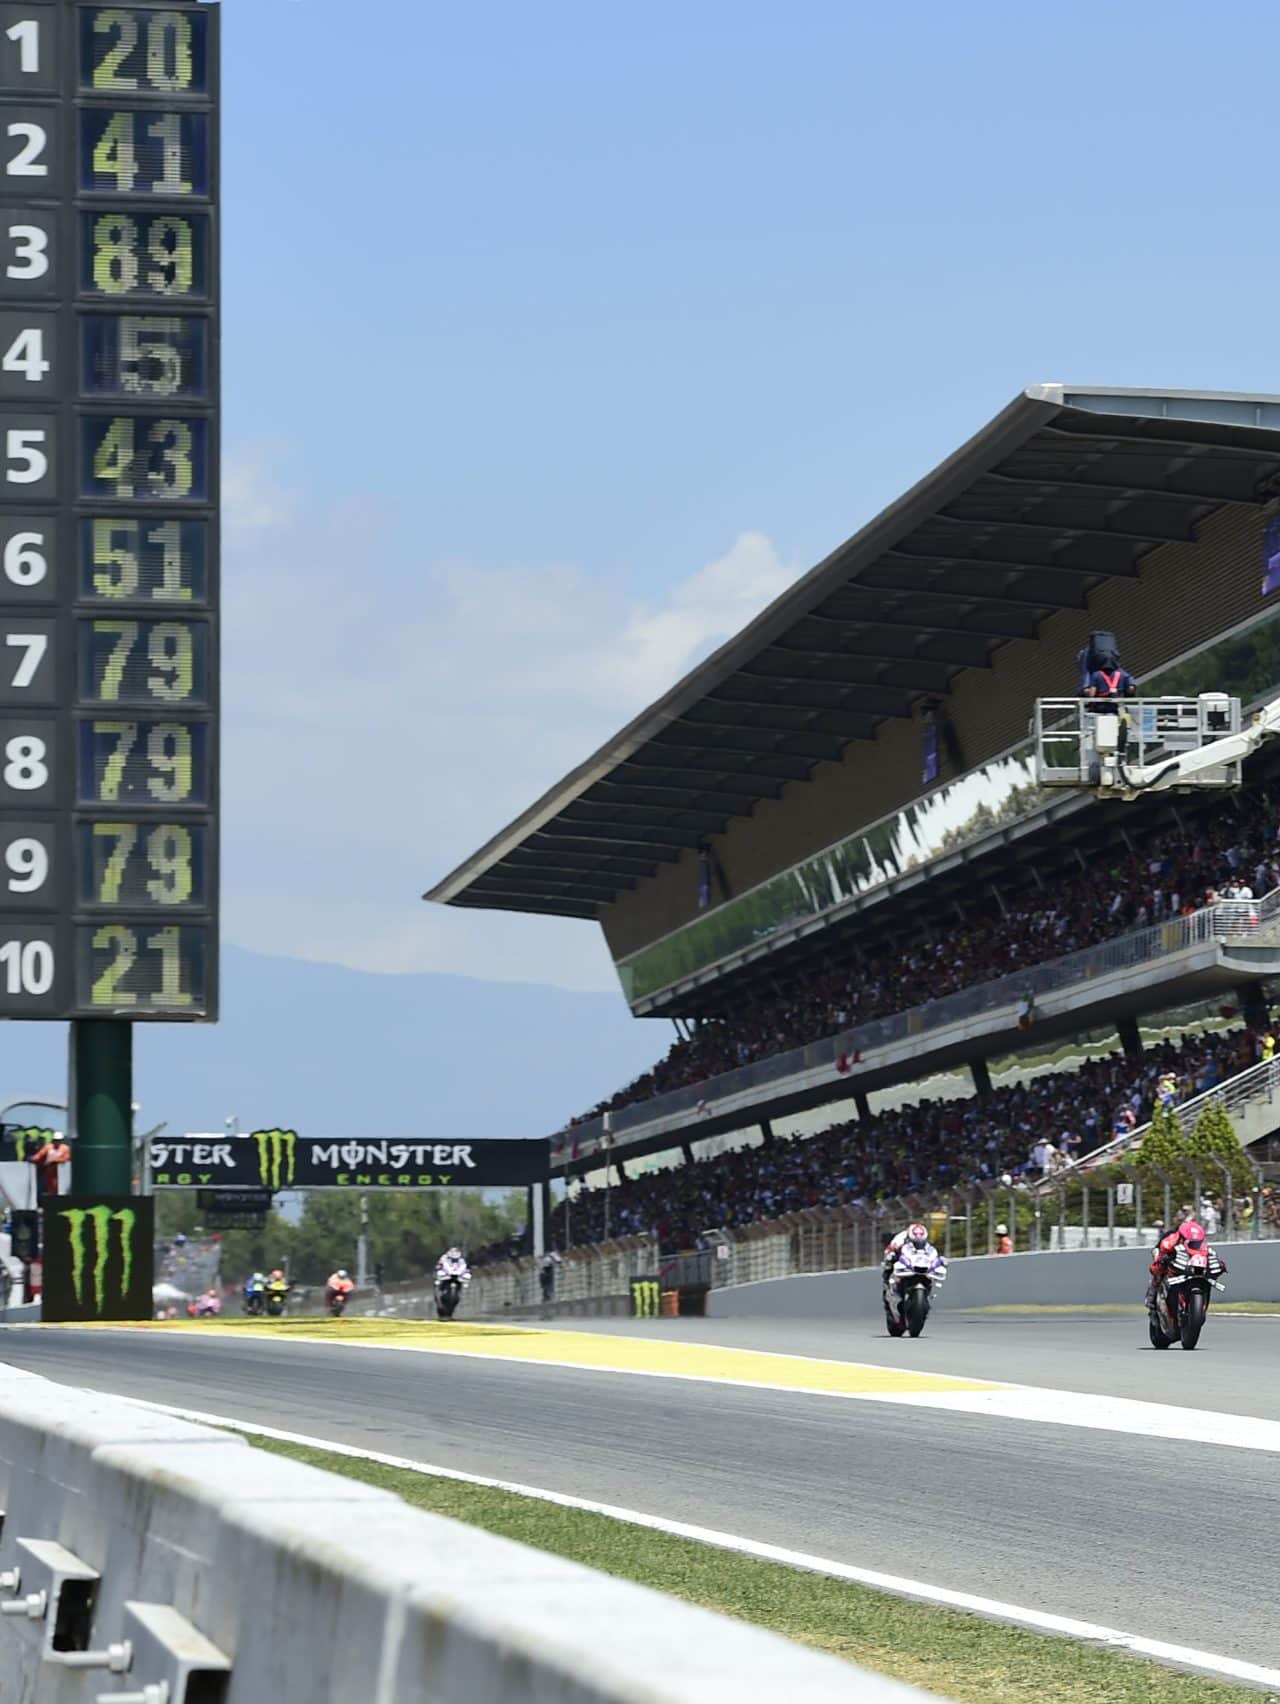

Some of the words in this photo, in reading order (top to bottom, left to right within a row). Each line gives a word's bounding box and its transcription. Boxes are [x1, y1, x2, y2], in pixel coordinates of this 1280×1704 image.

[6, 20, 40, 73] 1
[93, 9, 192, 91] 20
[6, 123, 48, 176] 2
[93, 112, 192, 194] 41
[6, 225, 49, 280] 3
[93, 214, 192, 295] 89
[2, 328, 49, 382] 4
[120, 315, 182, 396] 5
[6, 430, 47, 485] 5
[93, 418, 192, 499] 43
[3, 531, 46, 586] 6
[93, 519, 192, 600] 51
[5, 634, 47, 687] 7
[93, 620, 192, 701] 79
[3, 735, 48, 790] 8
[93, 721, 192, 801] 79
[5, 837, 49, 893] 9
[93, 823, 192, 904] 79
[0, 940, 55, 995] 10
[92, 926, 192, 1006] 21
[150, 1144, 236, 1167] STER
[157, 1173, 211, 1185] RGY
[311, 1140, 477, 1170] MONSTER
[337, 1173, 451, 1185] ENERGY
